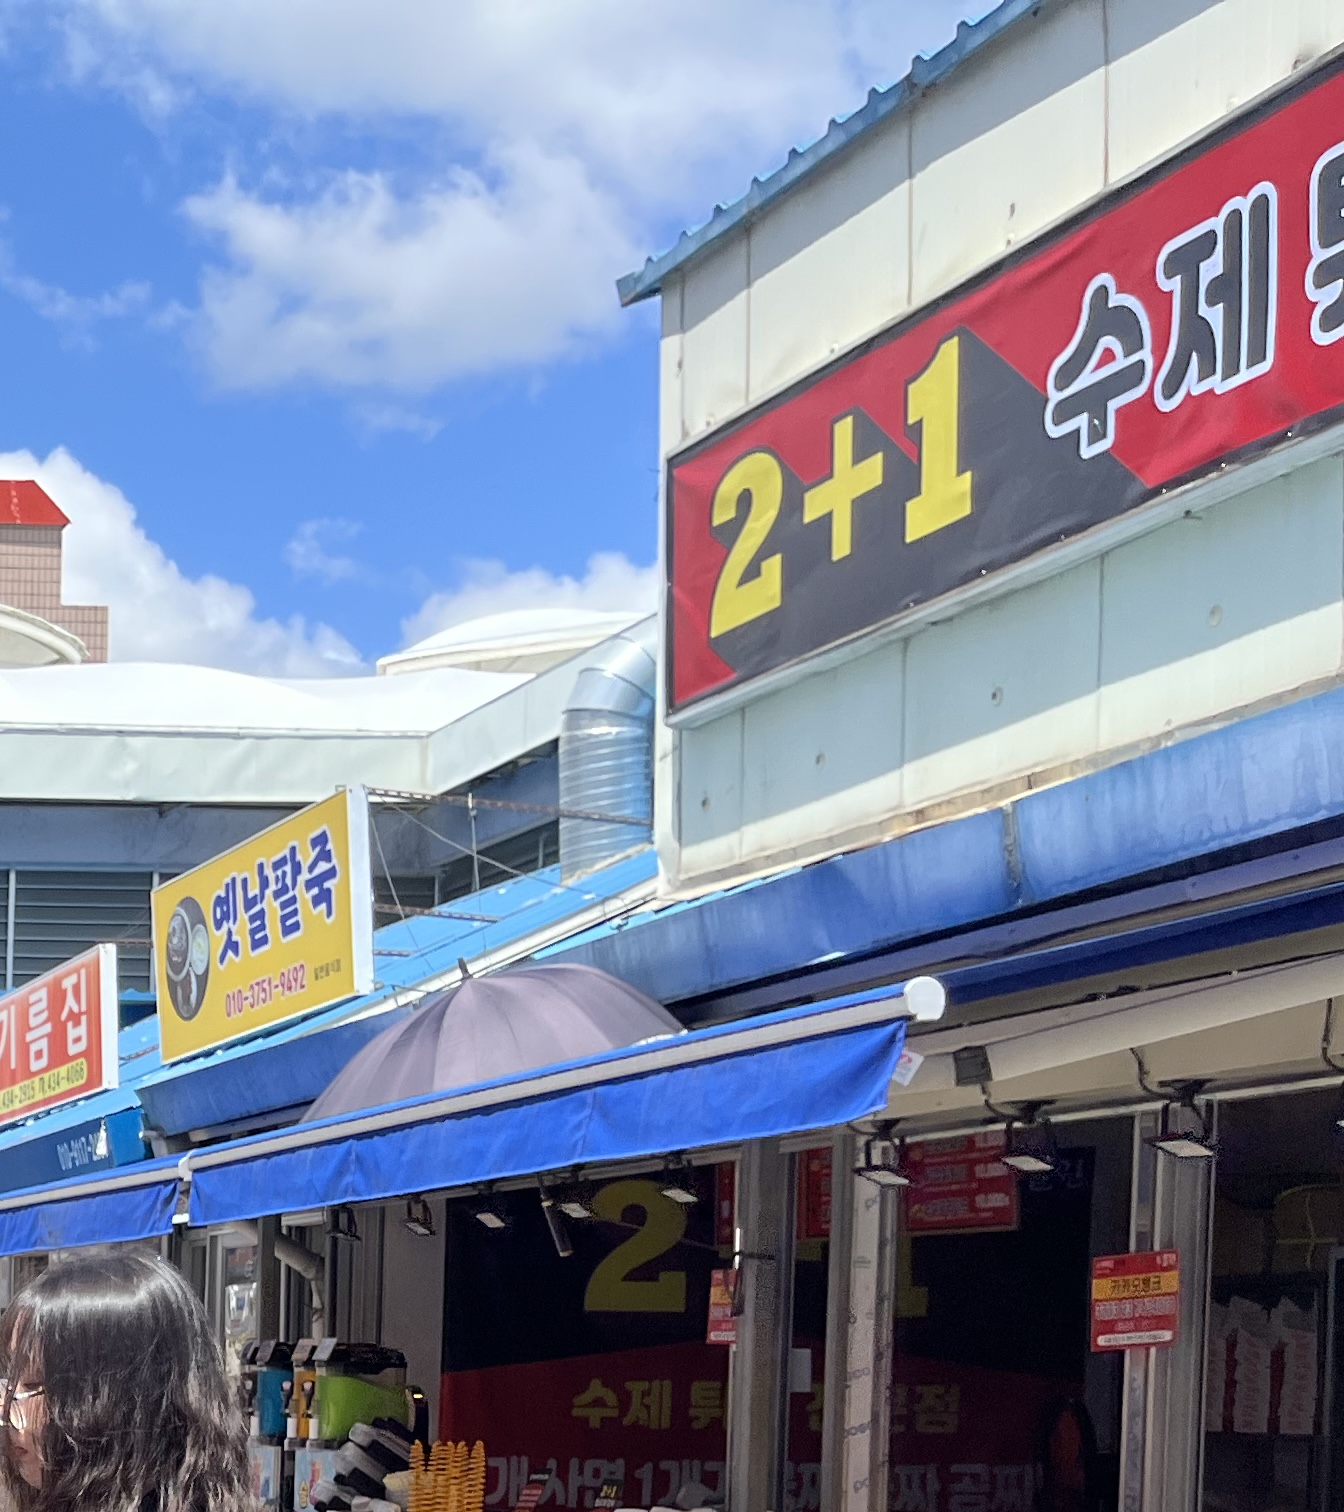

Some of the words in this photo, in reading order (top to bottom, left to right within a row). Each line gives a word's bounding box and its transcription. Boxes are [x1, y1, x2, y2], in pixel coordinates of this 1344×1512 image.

[1044, 180, 1280, 460] 수제
[710, 334, 973, 640] 2+1
[212, 826, 339, 968] 옛날팥죽
[225, 963, 307, 1018] 010-3751-9492
[570, 1374, 672, 1431] 수제
